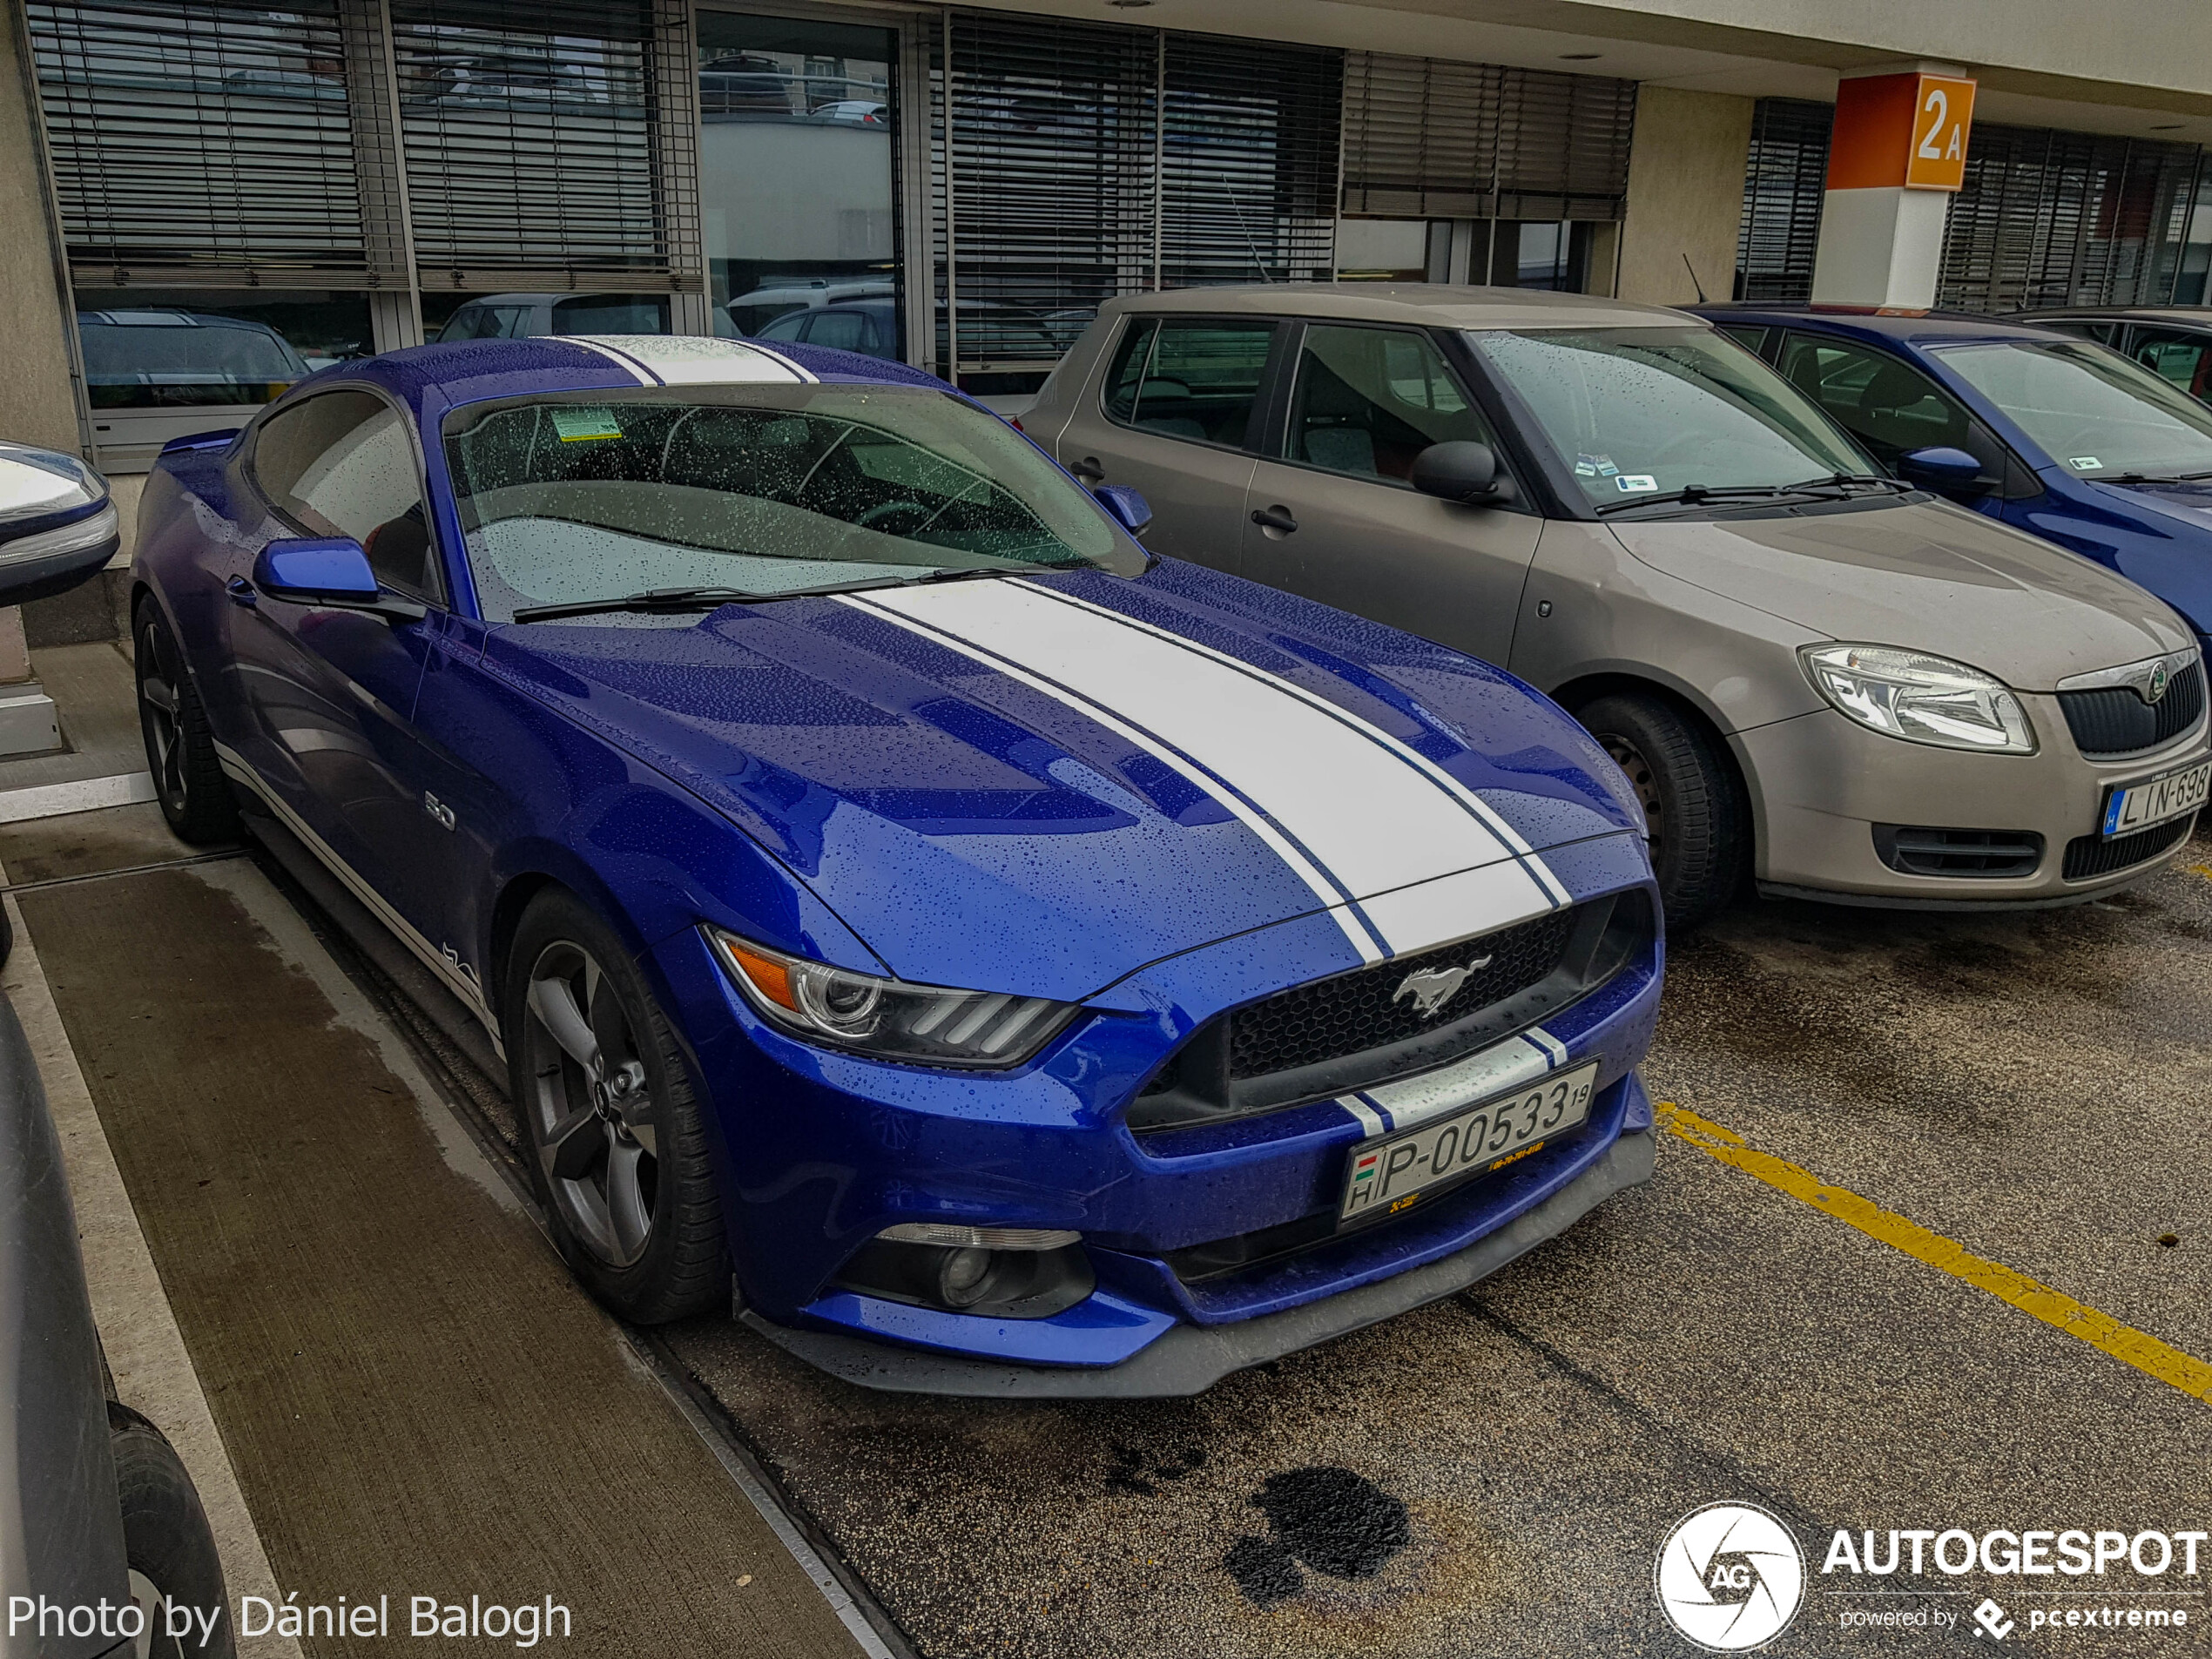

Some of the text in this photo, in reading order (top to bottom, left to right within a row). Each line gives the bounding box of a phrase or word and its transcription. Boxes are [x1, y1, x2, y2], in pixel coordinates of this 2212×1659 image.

[2122, 764, 2209, 826] LIN-698
[1380, 1080, 1570, 1198] P-00533
[1349, 1180, 1373, 1210] H
